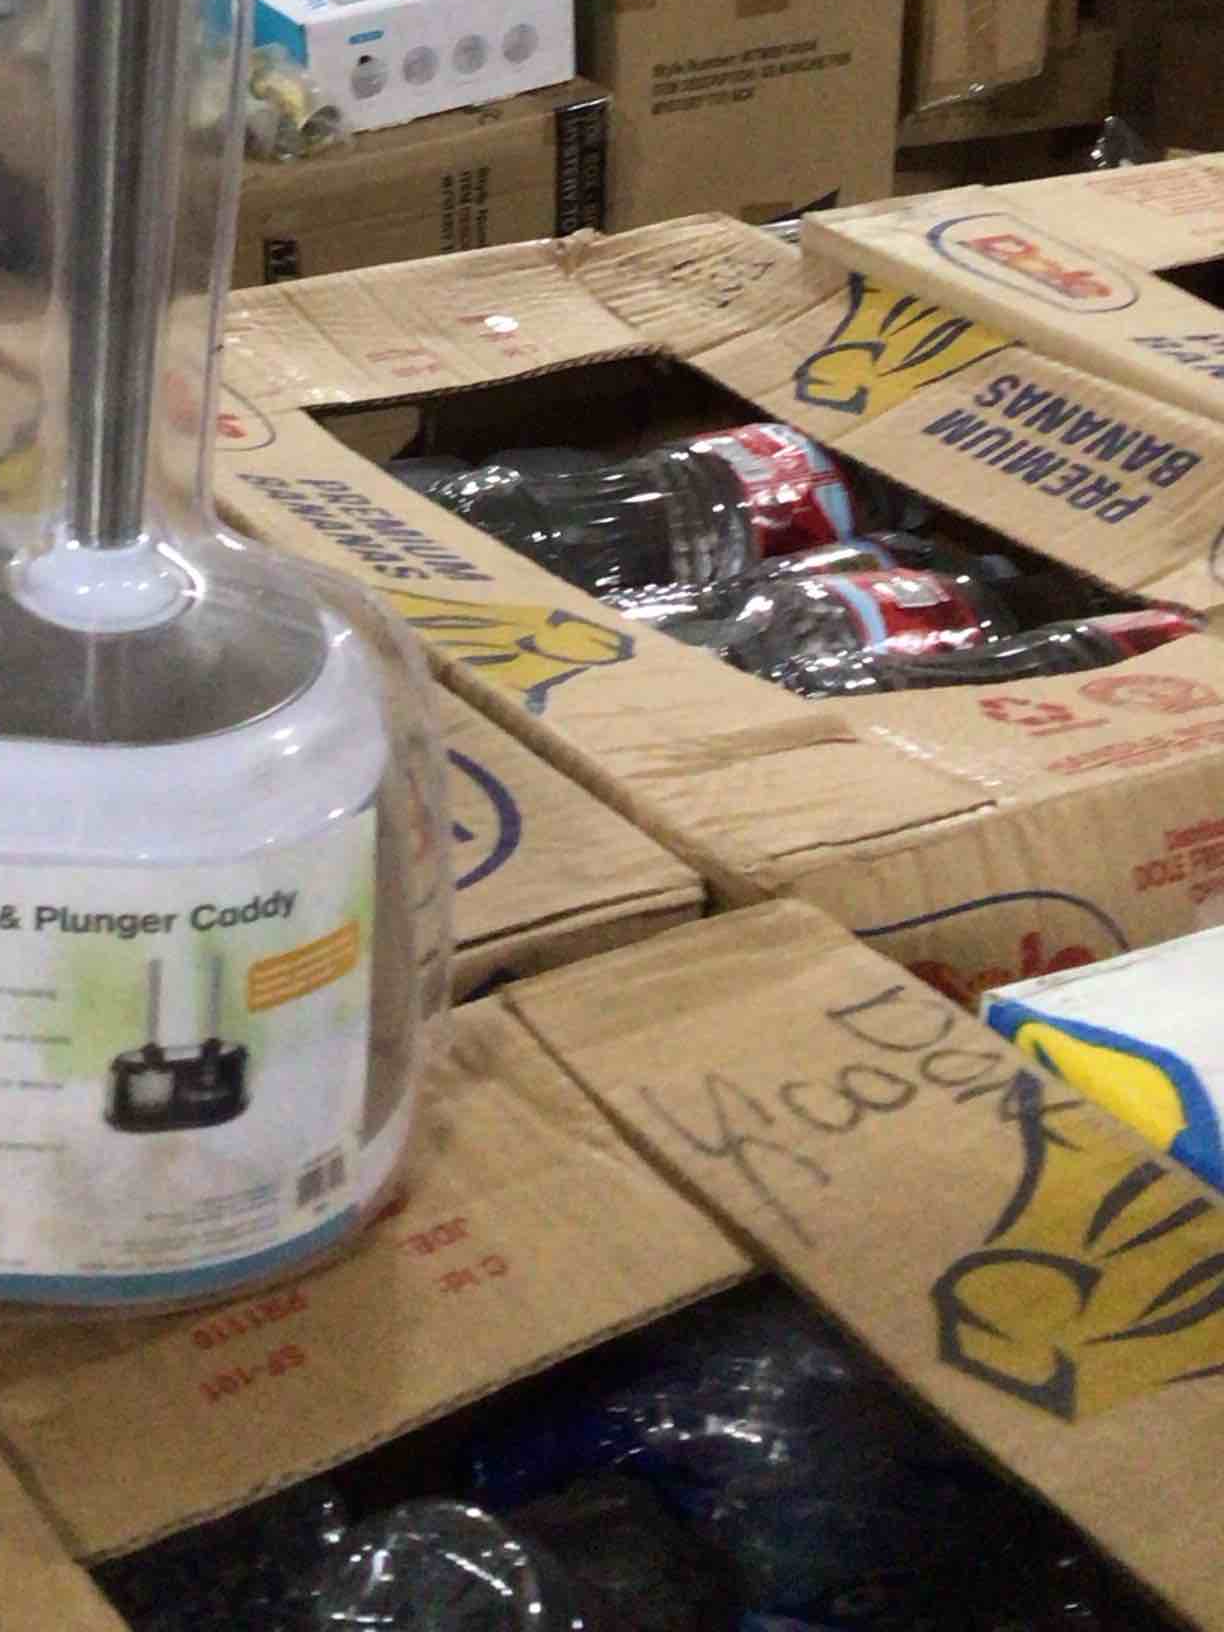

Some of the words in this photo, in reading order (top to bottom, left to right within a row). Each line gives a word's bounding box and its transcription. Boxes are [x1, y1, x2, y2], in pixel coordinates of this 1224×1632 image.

[921, 408, 1153, 525] PREMIUM
[973, 373, 1203, 489] BANANAS
[234, 472, 431, 580] BANANAS
[294, 478, 496, 582] PREMIUM
[33, 904, 180, 940] Plunger
[189, 888, 299, 933] Caddy
